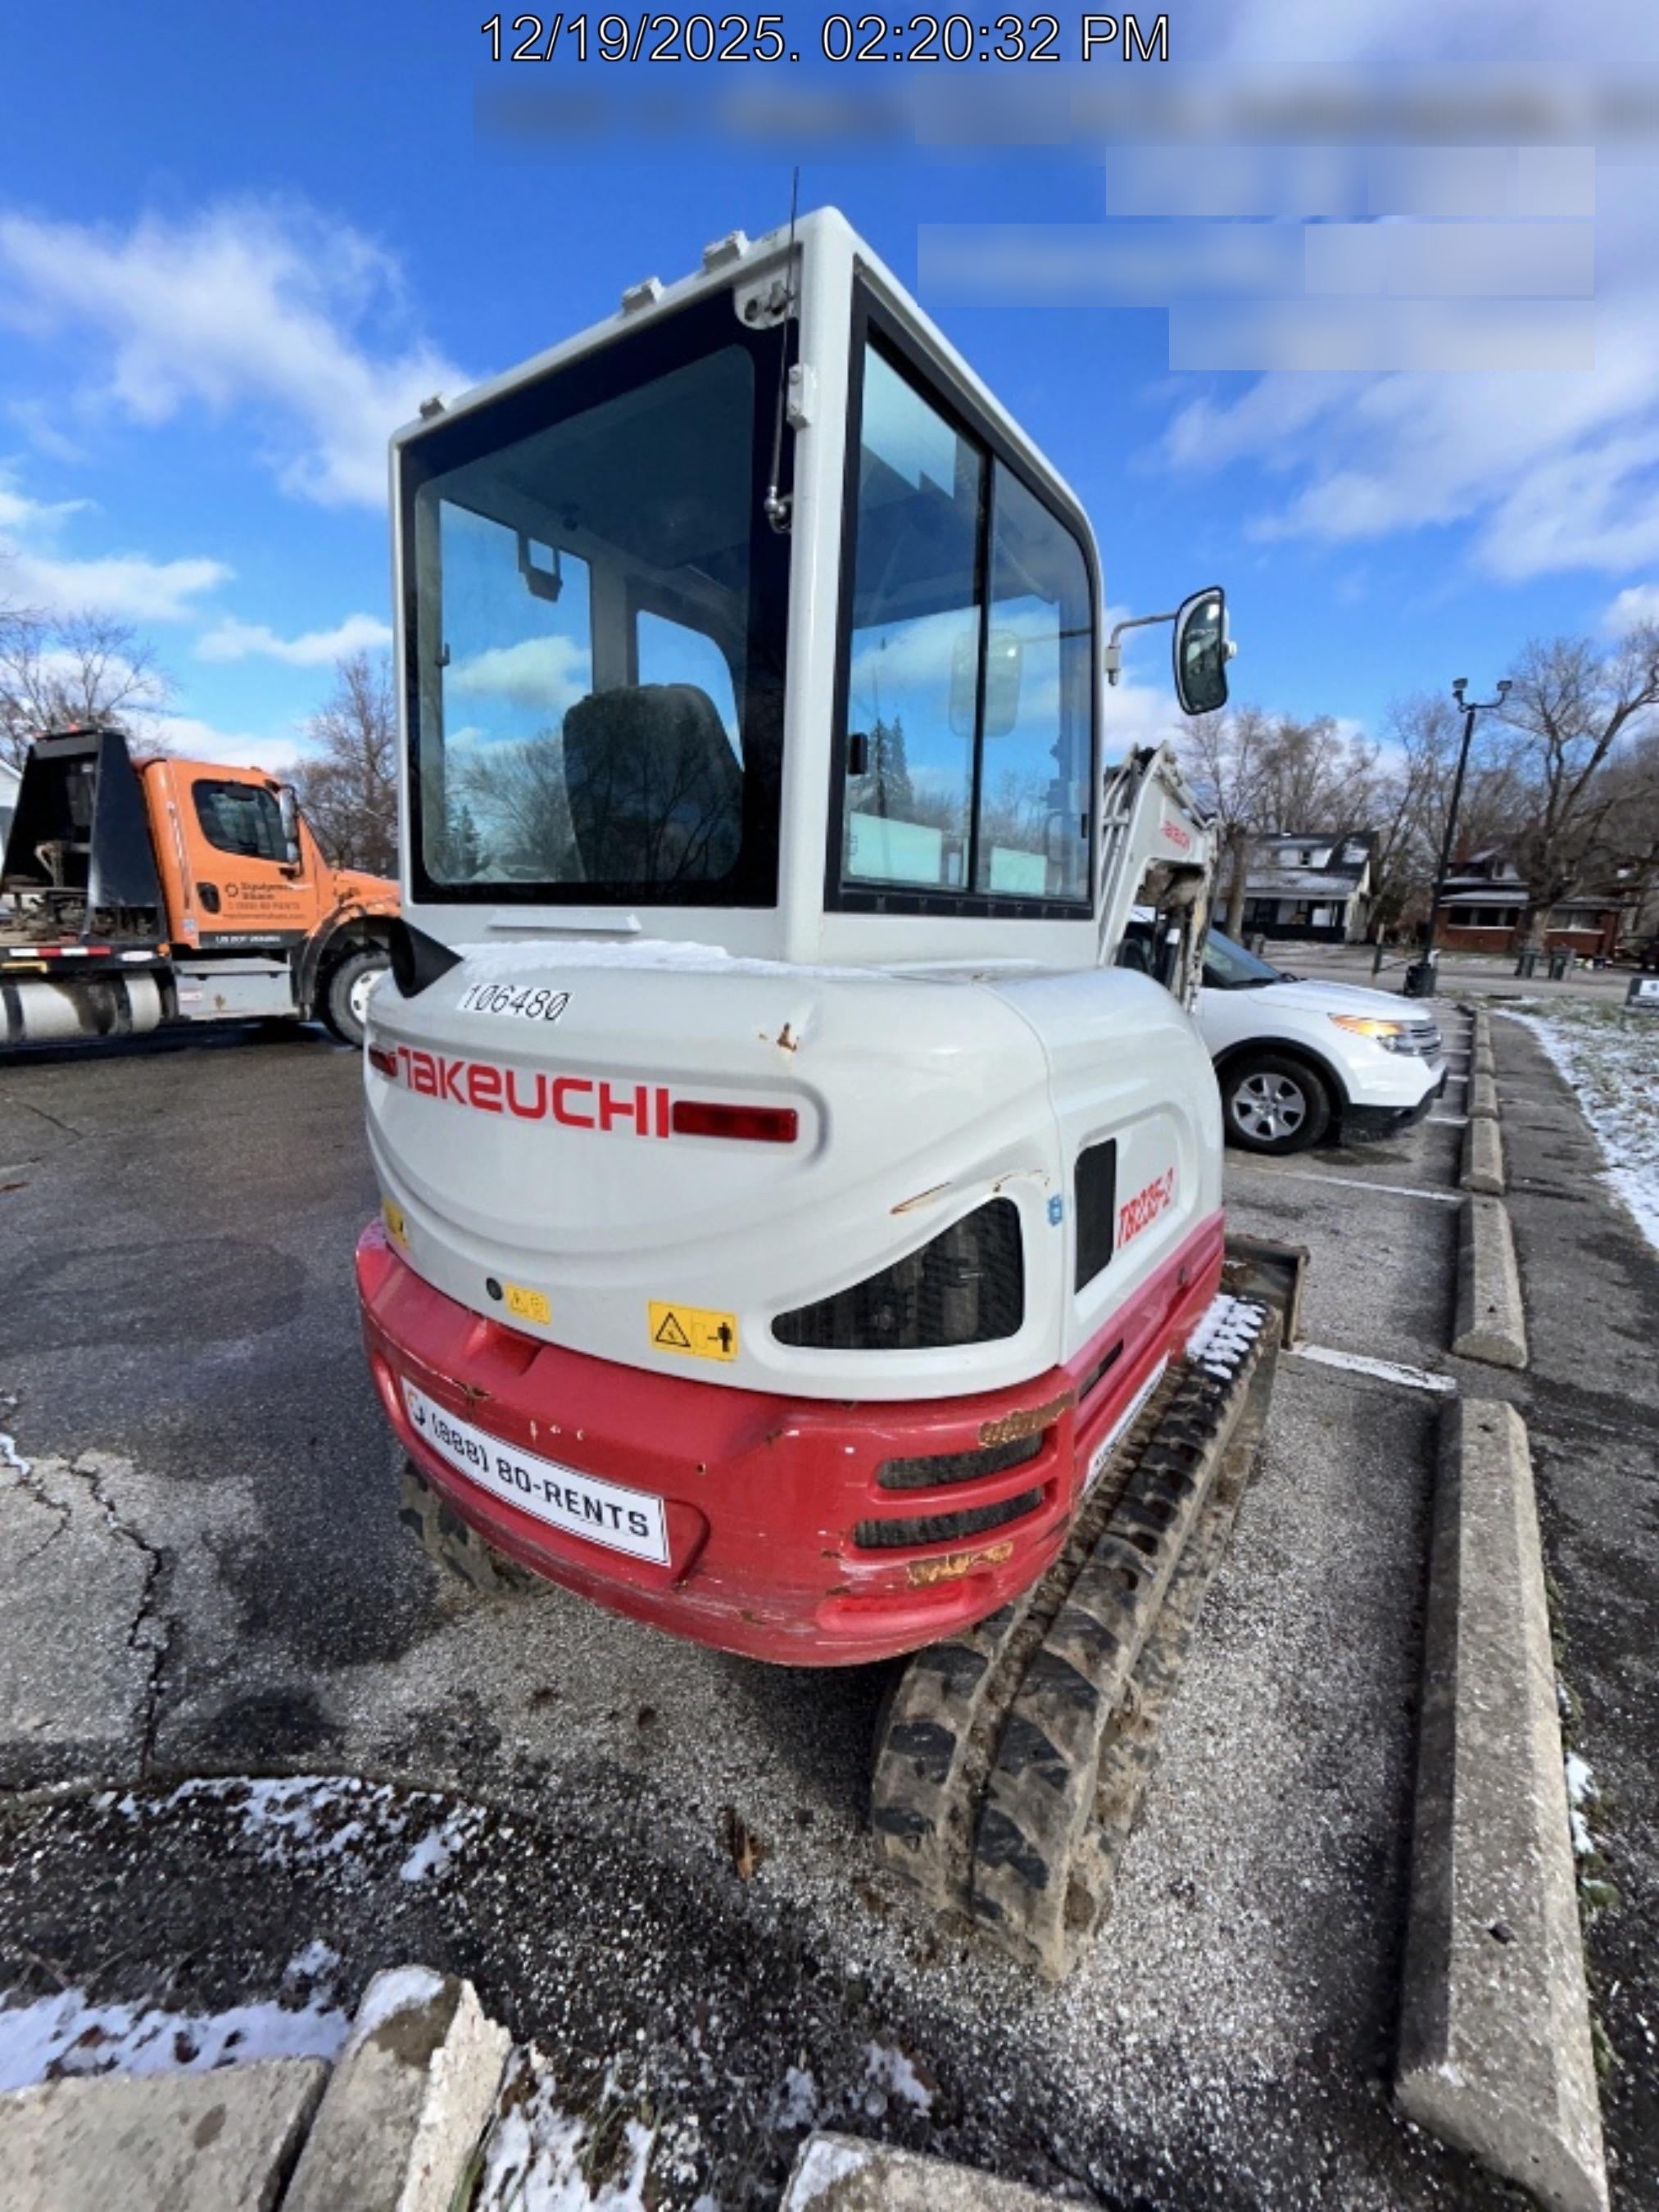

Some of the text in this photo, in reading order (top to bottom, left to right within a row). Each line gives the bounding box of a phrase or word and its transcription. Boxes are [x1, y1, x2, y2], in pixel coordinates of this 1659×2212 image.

[464, 985, 570, 1021] 106480
[431, 1412, 650, 1538] (888) 80-RENTS
